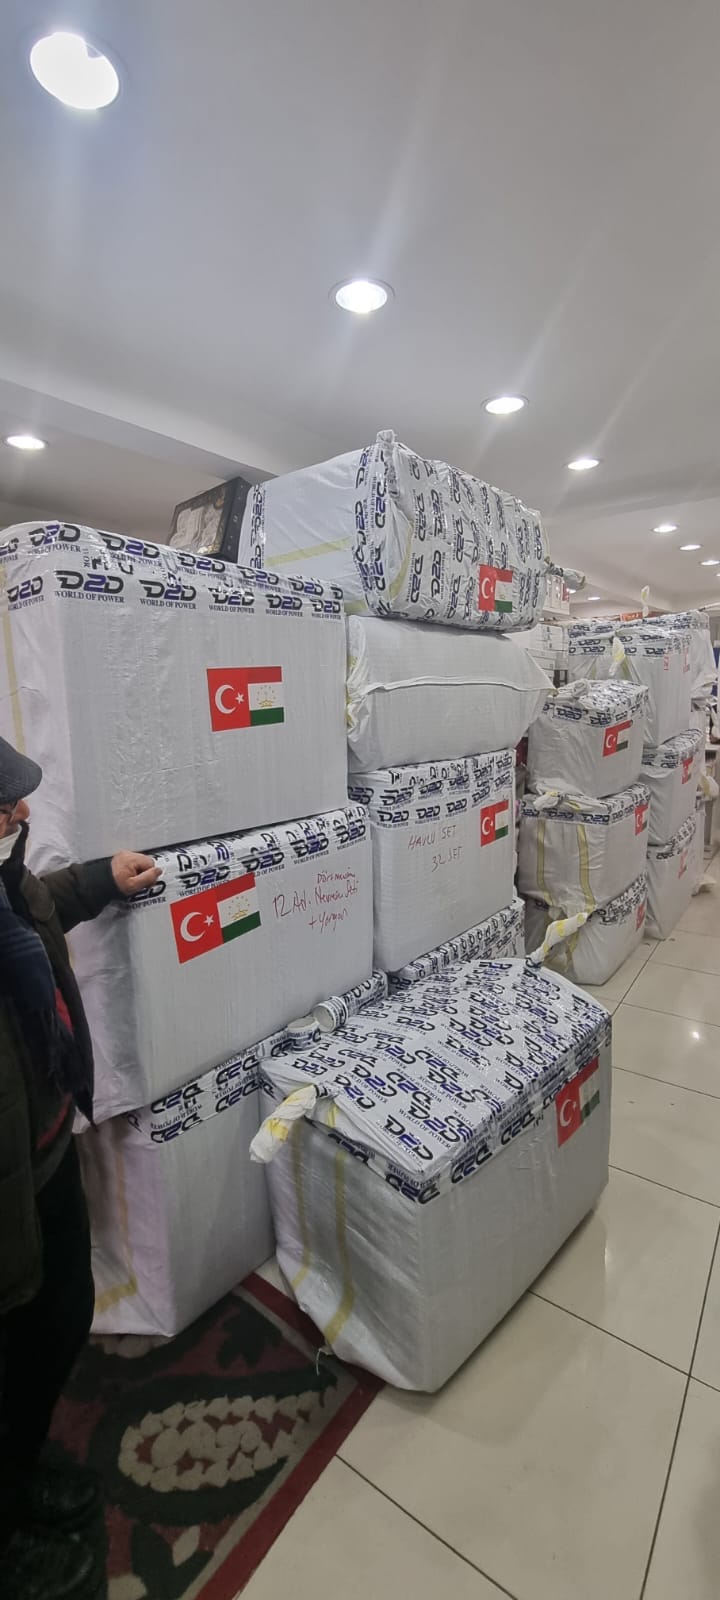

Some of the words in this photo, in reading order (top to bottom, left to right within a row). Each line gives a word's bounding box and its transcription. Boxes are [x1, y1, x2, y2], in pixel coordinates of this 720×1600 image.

[375, 481, 387, 528] D2D
[431, 489, 443, 537] D2D
[418, 493, 427, 541] D2D
[28, 524, 81, 546] D2D
[98, 532, 160, 559] D2D
[456, 516, 464, 563] D2D
[177, 552, 226, 573] D2D
[431, 551, 442, 597] D2D
[54, 570, 124, 594] D2D
[236, 565, 279, 585] D2D
[288, 577, 324, 597] D2D
[411, 555, 423, 603] D2D
[7, 576, 43, 602] D2D
[55, 590, 84, 600] WORLD
[86, 592, 95, 601] OF
[98, 594, 124, 603] POWER
[139, 579, 197, 602] D2D
[208, 586, 255, 606] D2D
[140, 600, 164, 608] WORLD
[175, 602, 196, 610] POWER
[208, 604, 228, 612] WORLD
[229, 605, 237, 613] OF
[237, 606, 255, 614] POWER
[265, 593, 303, 610] D2D
[265, 608, 281, 616] WORLD
[281, 609, 288, 617] OF
[310, 599, 341, 614] D2D
[581, 646, 606, 654] D2D
[556, 706, 583, 720] D2D
[378, 810, 410, 823] D2D
[416, 805, 441, 819] D2D
[446, 798, 467, 813] D2D
[582, 813, 611, 823] D2D
[441, 825, 457, 840] SET
[241, 852, 285, 873] D2D
[269, 863, 285, 873] POWER
[431, 855, 446, 873] 32
[176, 867, 231, 889] D2D
[273, 894, 291, 918] 12
[332, 1028, 367, 1043] D2D
[396, 1016, 436, 1031] D2D
[449, 1017, 493, 1047] D2D
[470, 1016, 514, 1045] D2D
[309, 1051, 345, 1068] D2D
[375, 1041, 416, 1065] D2D
[445, 1034, 492, 1066] D2D
[216, 1054, 260, 1085] D2D
[292, 1058, 328, 1075] D2D
[415, 1049, 460, 1083] D2D
[334, 1074, 376, 1109] D2D
[352, 1064, 398, 1097] D2D
[386, 1071, 432, 1106] D2D
[427, 1067, 476, 1103] D2D
[151, 1083, 205, 1114] D2D
[215, 1079, 260, 1113] D2D
[151, 1112, 204, 1143] D2D
[399, 1109, 420, 1126] WORLD
[429, 1132, 452, 1149] POWER
[408, 1101, 460, 1143] D2D
[501, 1109, 535, 1145] D2D
[385, 1114, 434, 1160] D2D
[451, 1140, 493, 1184] D2D
[386, 1173, 441, 1204] D2D
